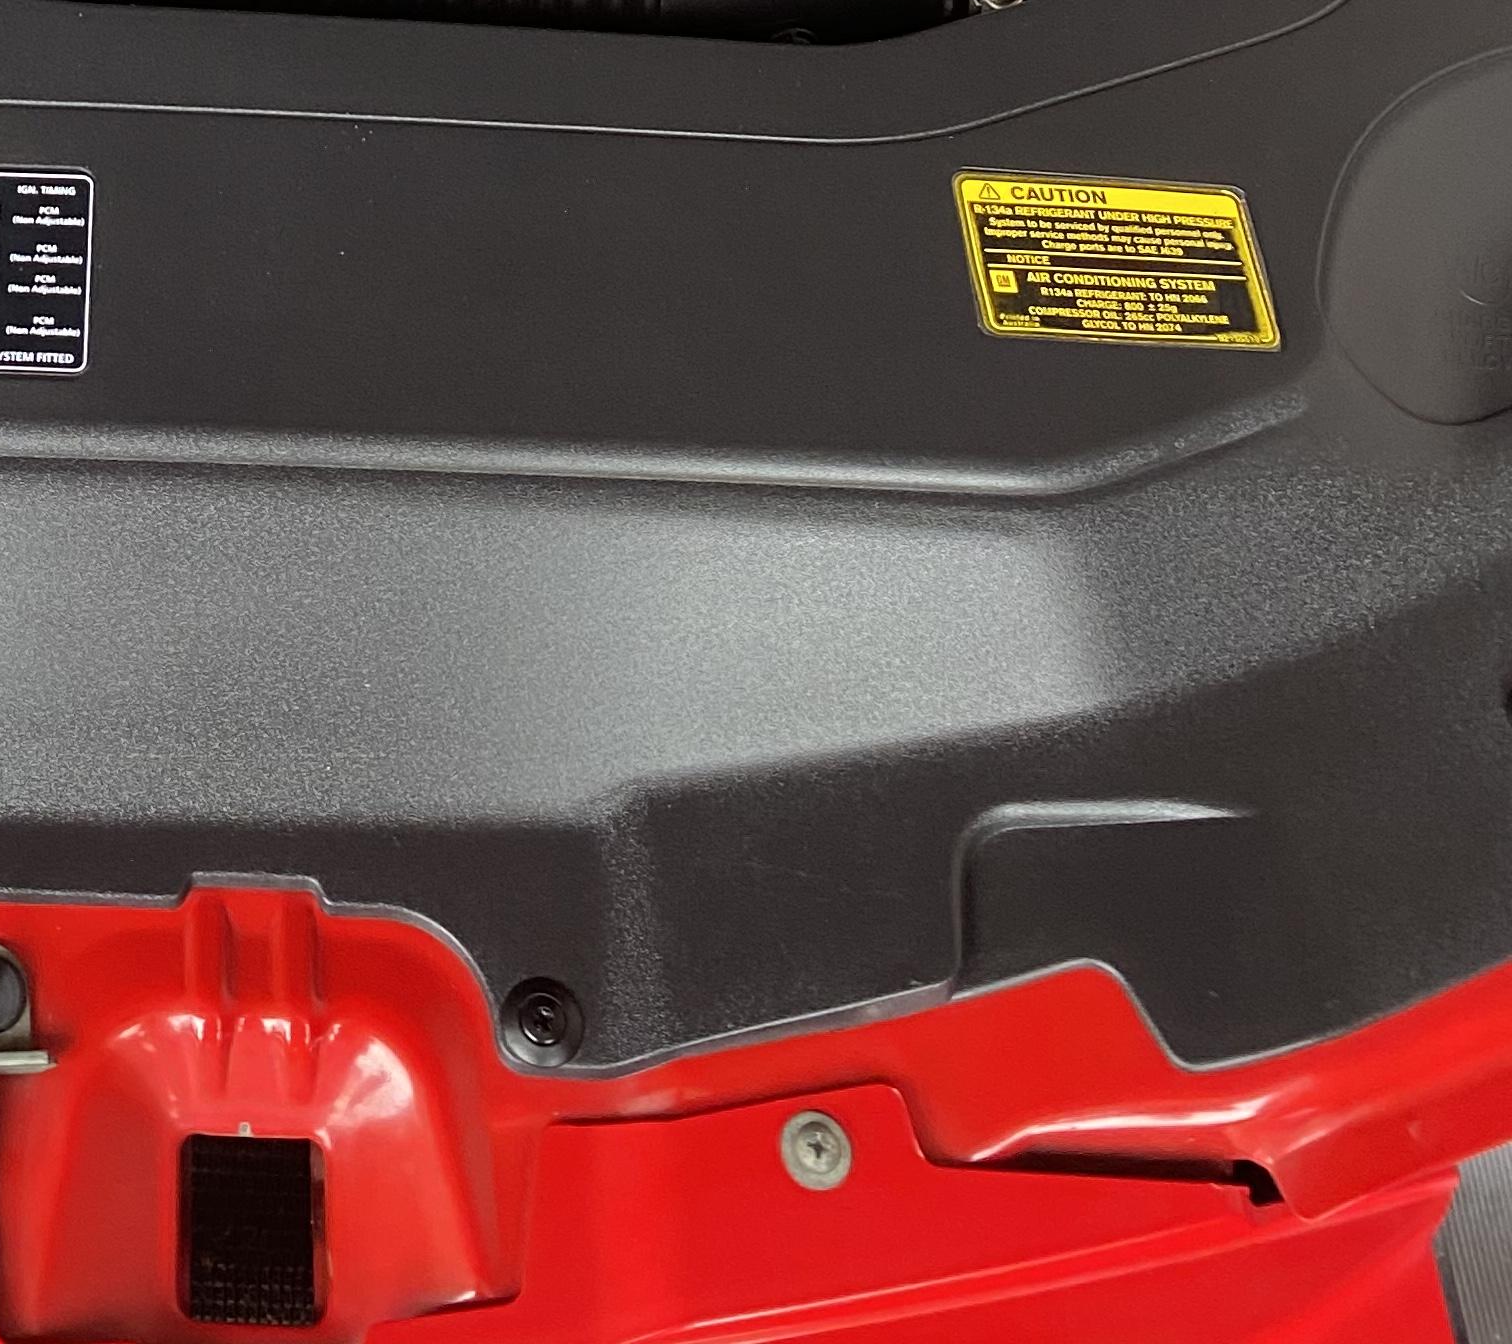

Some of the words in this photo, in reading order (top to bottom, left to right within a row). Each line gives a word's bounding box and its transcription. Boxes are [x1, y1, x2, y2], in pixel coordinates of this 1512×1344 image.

[1011, 186, 1106, 204] CAUTION
[1015, 206, 1095, 219] REFRIGERANT
[1098, 211, 1140, 222] UNDER
[1142, 214, 1171, 223] HIGH
[1173, 216, 1234, 229] PRESSURE
[1007, 254, 1051, 265] NOTICE
[1027, 272, 1051, 283] AIR
[1054, 272, 1156, 288] CONDITIONING
[1159, 279, 1216, 291] SYSTEM
[1028, 306, 1101, 318] COMPRESSOR
[1082, 319, 1120, 329] GLYCOL
[1122, 322, 1136, 330] TO
[36, 352, 74, 363] FITTED
